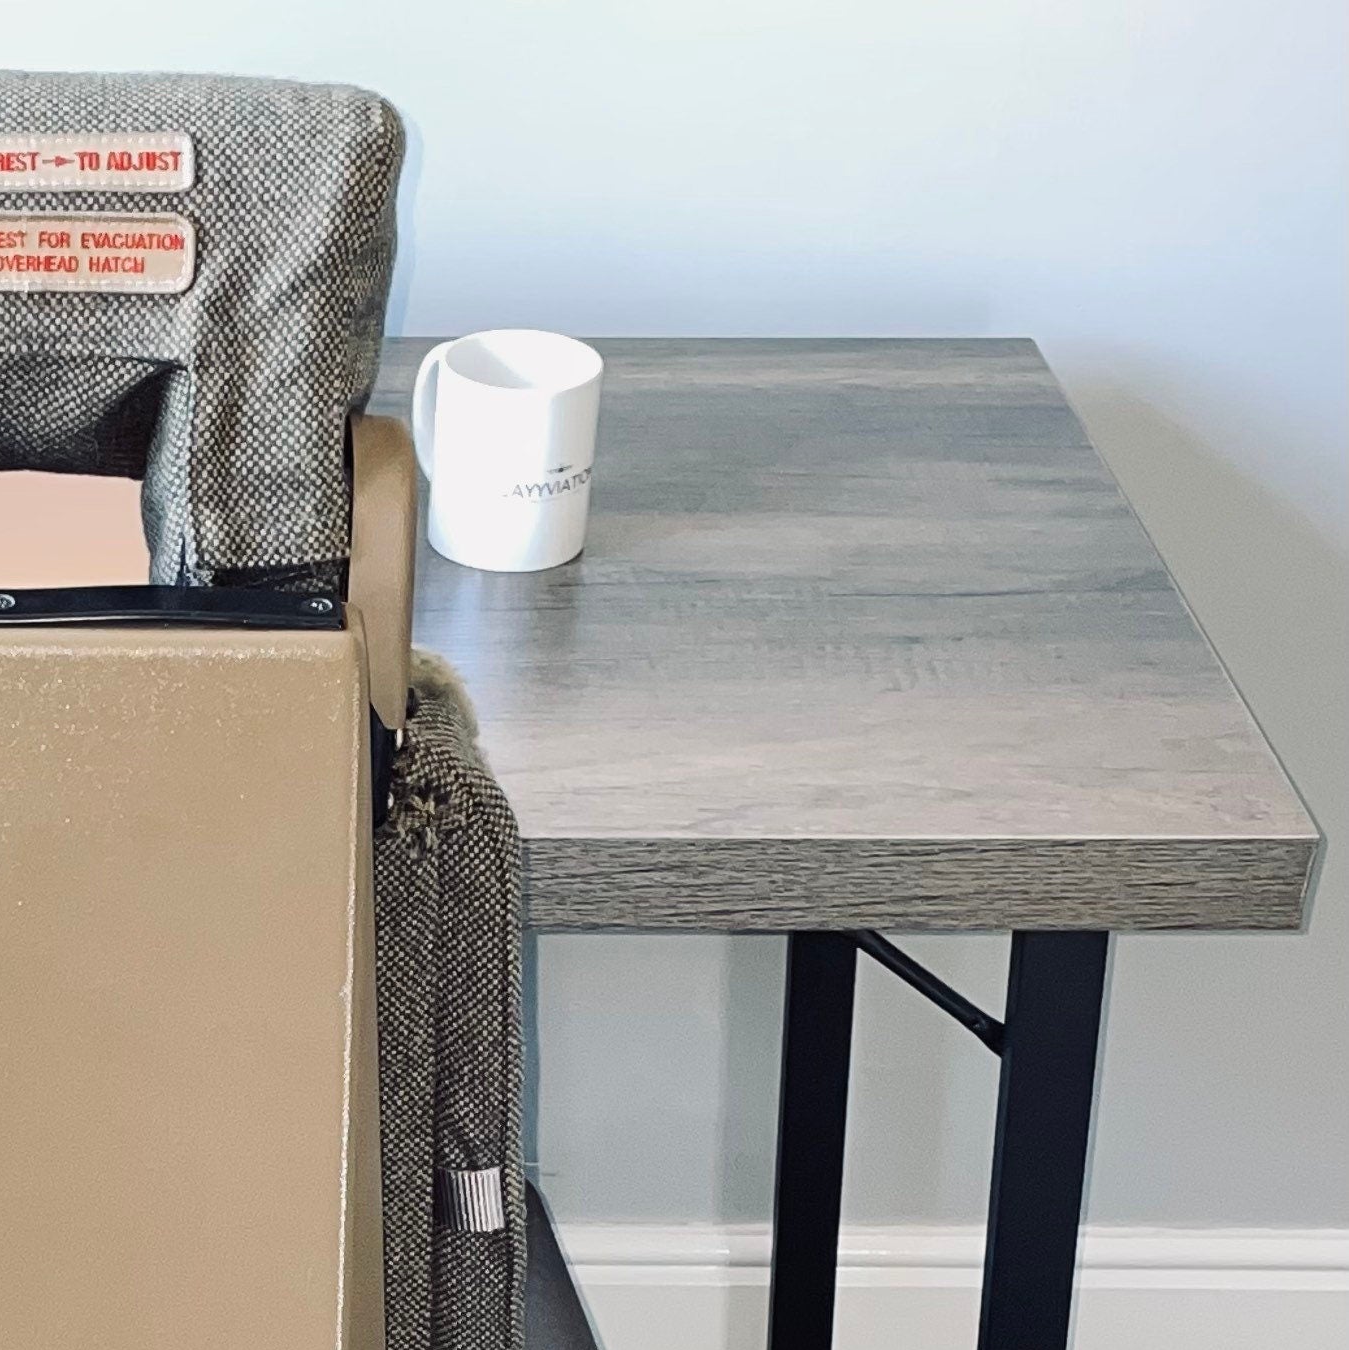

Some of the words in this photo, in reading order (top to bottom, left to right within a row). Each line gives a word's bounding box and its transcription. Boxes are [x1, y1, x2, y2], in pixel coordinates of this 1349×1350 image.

[75, 151, 101, 172] TO
[106, 150, 182, 173] ADJUST
[37, 230, 72, 250] FOR
[80, 231, 186, 252] EVACUATION
[88, 255, 146, 274] HATCH
